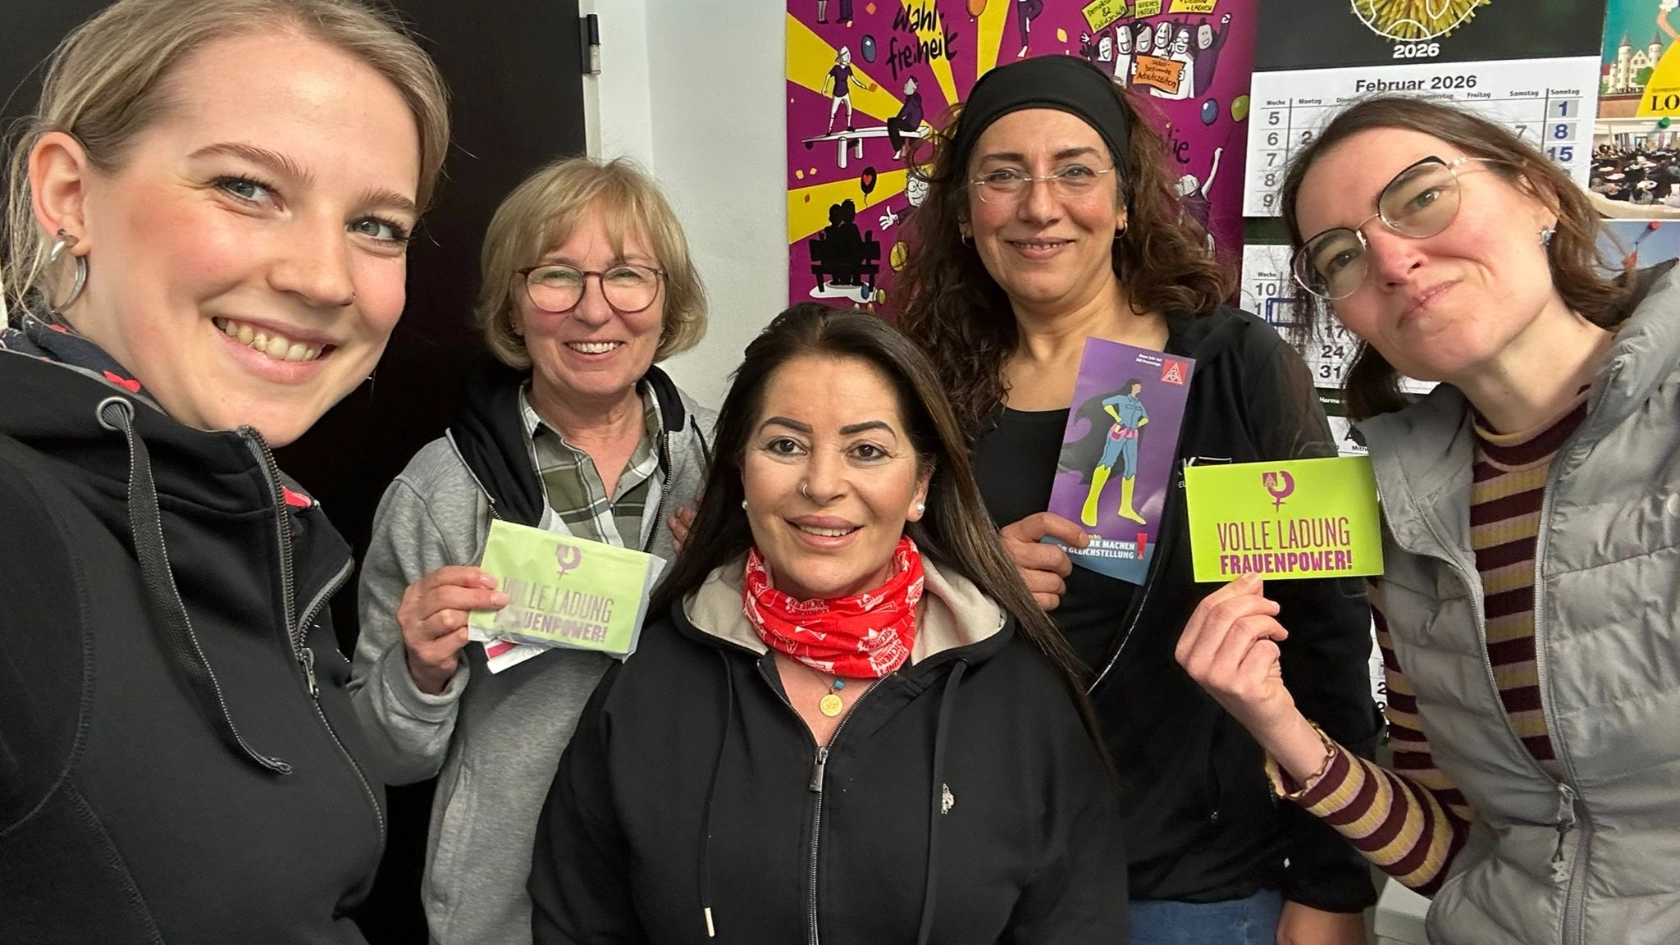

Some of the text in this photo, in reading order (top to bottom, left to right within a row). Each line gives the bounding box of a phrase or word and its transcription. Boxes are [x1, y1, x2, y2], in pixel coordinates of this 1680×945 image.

[1393, 43, 1440, 59] 2026
[1355, 75, 1477, 93] Februar 2026
[1298, 98, 1322, 106] Montag
[1268, 101, 1568, 126] 5 1
[1267, 124, 1569, 146] 6 2 7 8
[1266, 146, 1574, 167] 7 15
[1264, 173, 1276, 187] 8
[1263, 194, 1274, 208] 9
[1255, 283, 1277, 296] 10
[1325, 325, 1345, 339] 17
[1321, 345, 1345, 359] 24
[1319, 365, 1341, 379] 31
[1217, 517, 1351, 552] VOLLE LADUNG
[1102, 540, 1135, 551] MACHEN
[1068, 547, 1135, 560] GLEICHSTELLUNG
[1220, 550, 1353, 575] FRAUENPOWER!
[551, 587, 615, 624] LADUNG
